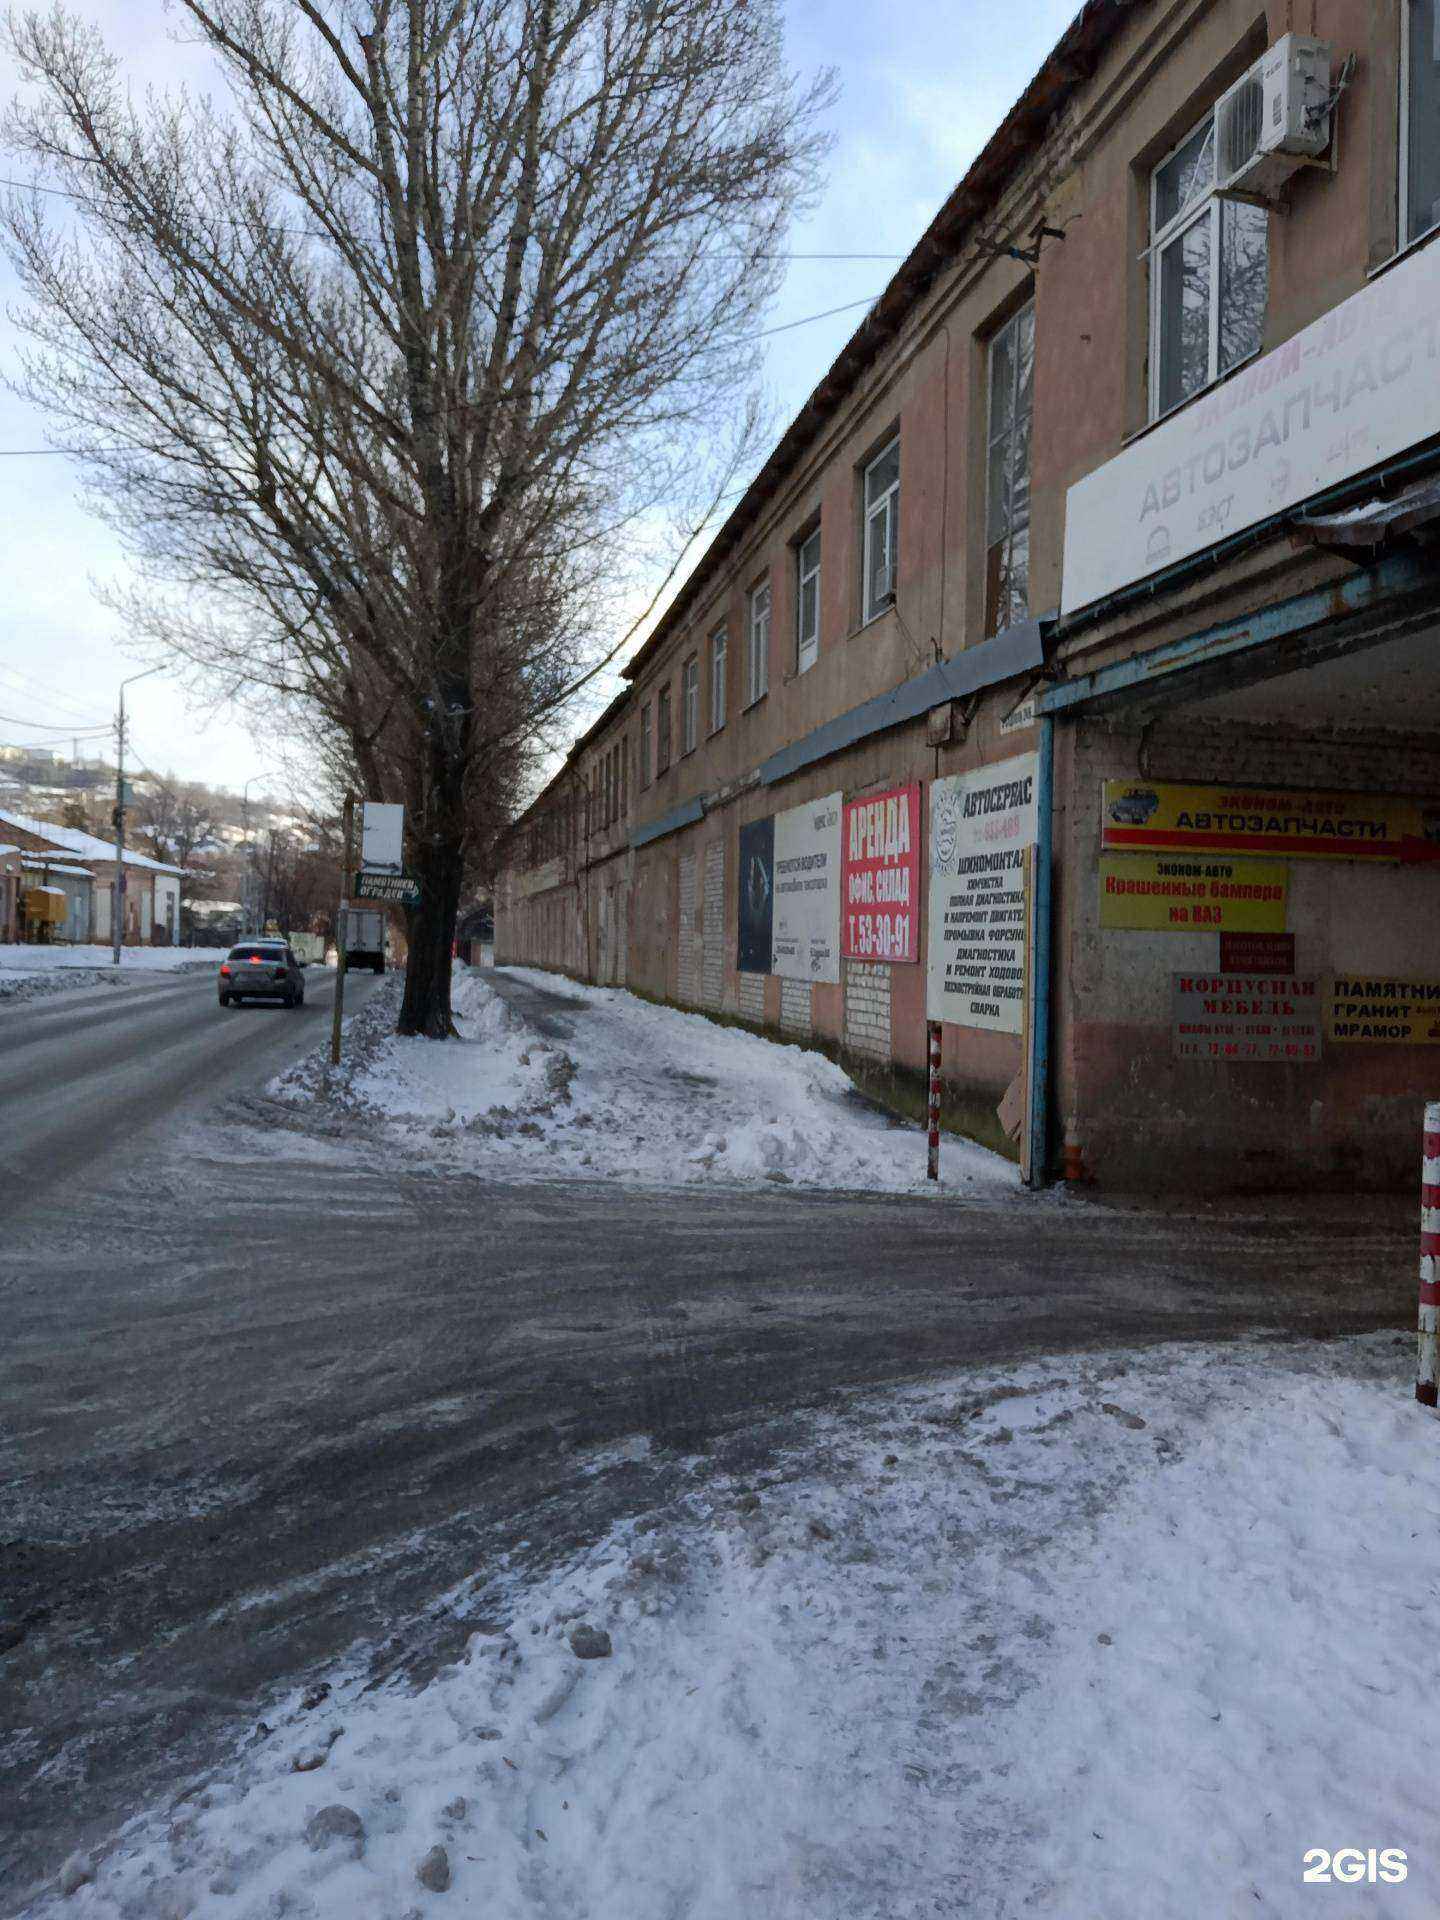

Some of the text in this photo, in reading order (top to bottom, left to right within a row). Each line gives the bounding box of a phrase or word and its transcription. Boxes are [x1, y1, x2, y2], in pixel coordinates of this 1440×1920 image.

[849, 794, 910, 865] АРЕНДА
[1176, 811, 1388, 838] АВТОЗАПЧАСТИ
[876, 867, 910, 906] СКЛАД
[1193, 905, 1222, 923] ВАЗ
[944, 929, 985, 941] ПРОМЫВКА
[956, 948, 1016, 962] ДИАГНОСТИКА
[946, 964, 1024, 980] И РЕМОНТ ХОДОВО
[1180, 978, 1315, 995] КОРПУСНАЯ
[970, 1002, 1000, 1017] СВАРКА
[1203, 999, 1294, 1015] МЕБЕЛЬ
[1334, 1003, 1411, 1018] ГРАНИТ
[1334, 1023, 1412, 1037] МРАМОР
